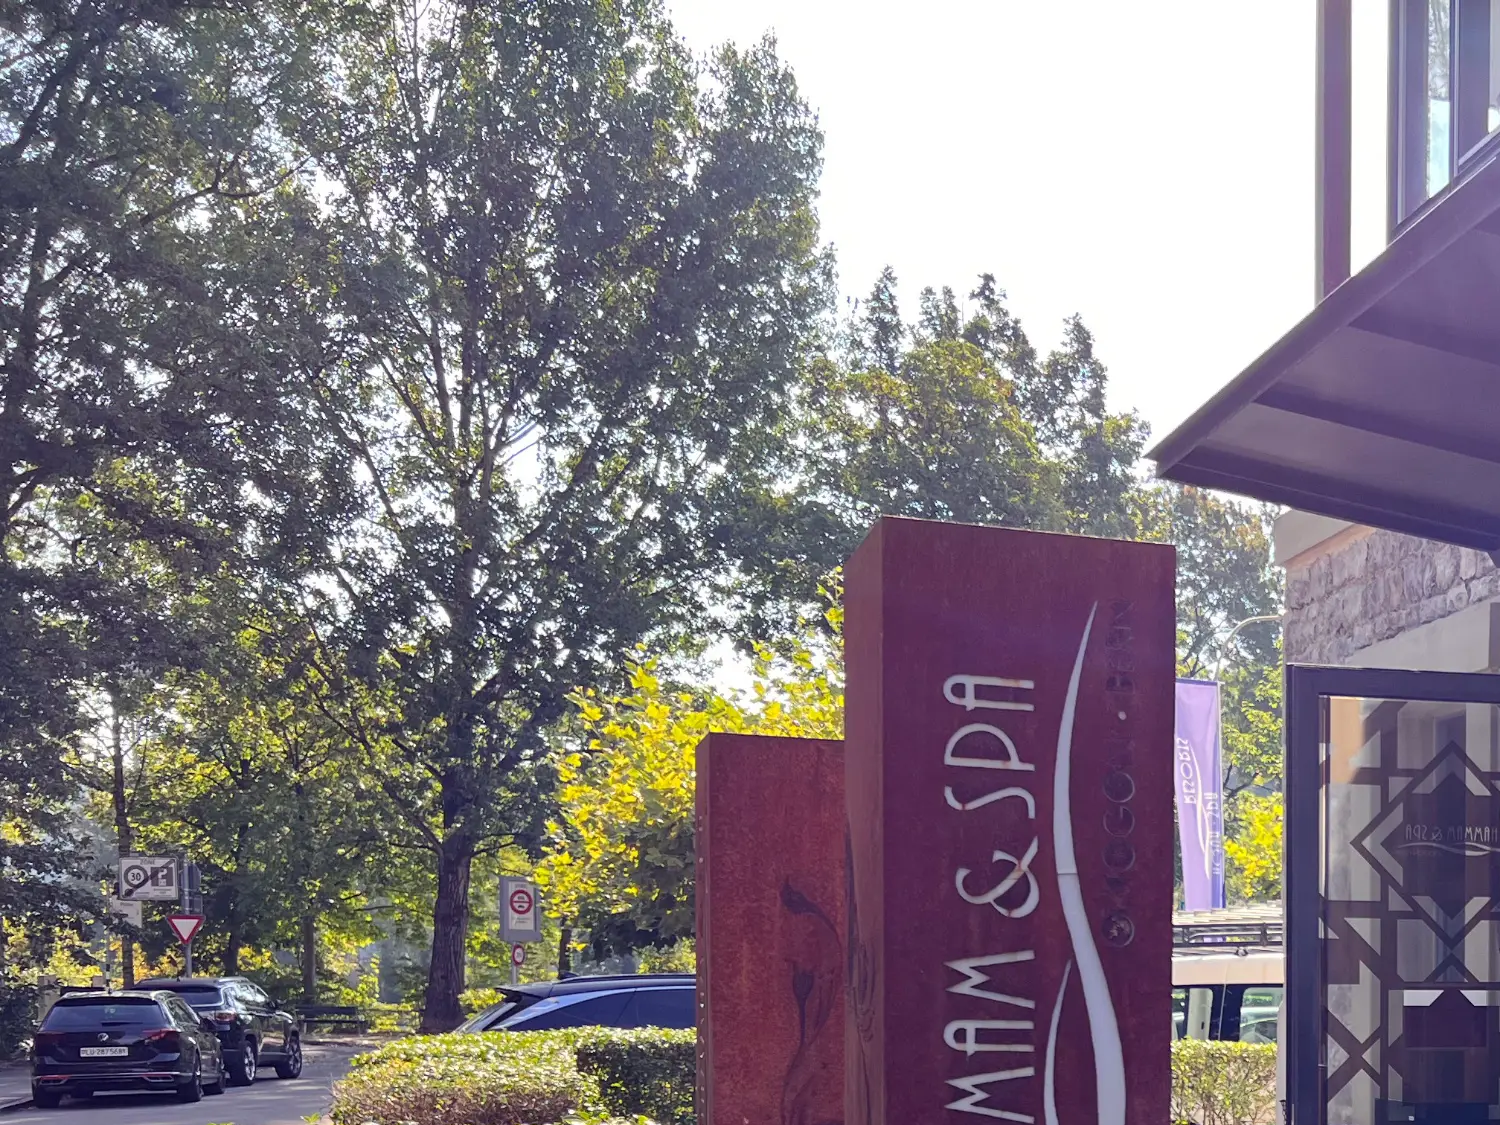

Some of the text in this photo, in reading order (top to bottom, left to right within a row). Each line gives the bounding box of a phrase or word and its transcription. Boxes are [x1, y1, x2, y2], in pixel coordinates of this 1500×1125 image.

[943, 674, 1036, 819] SPA
[130, 872, 142, 882] 30
[954, 836, 1040, 918] &
